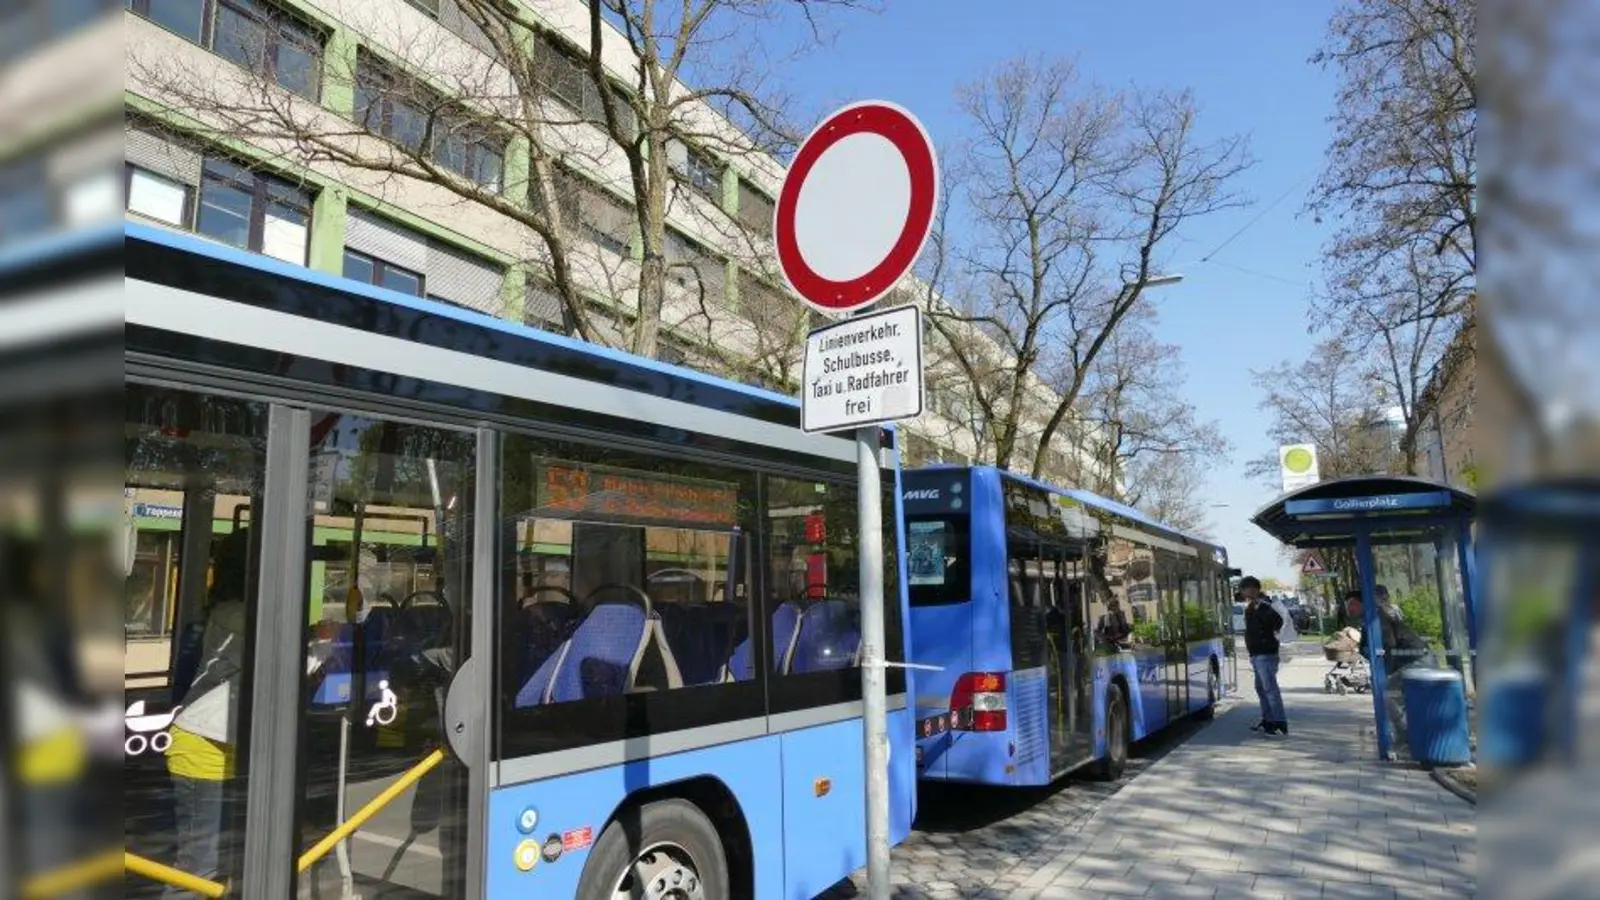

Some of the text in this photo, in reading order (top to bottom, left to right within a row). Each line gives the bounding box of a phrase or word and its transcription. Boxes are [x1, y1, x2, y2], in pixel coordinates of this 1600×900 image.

[812, 369, 909, 398] Taxi u. Radfahrer
[845, 397, 871, 416] frei
[903, 489, 940, 500] MVG
